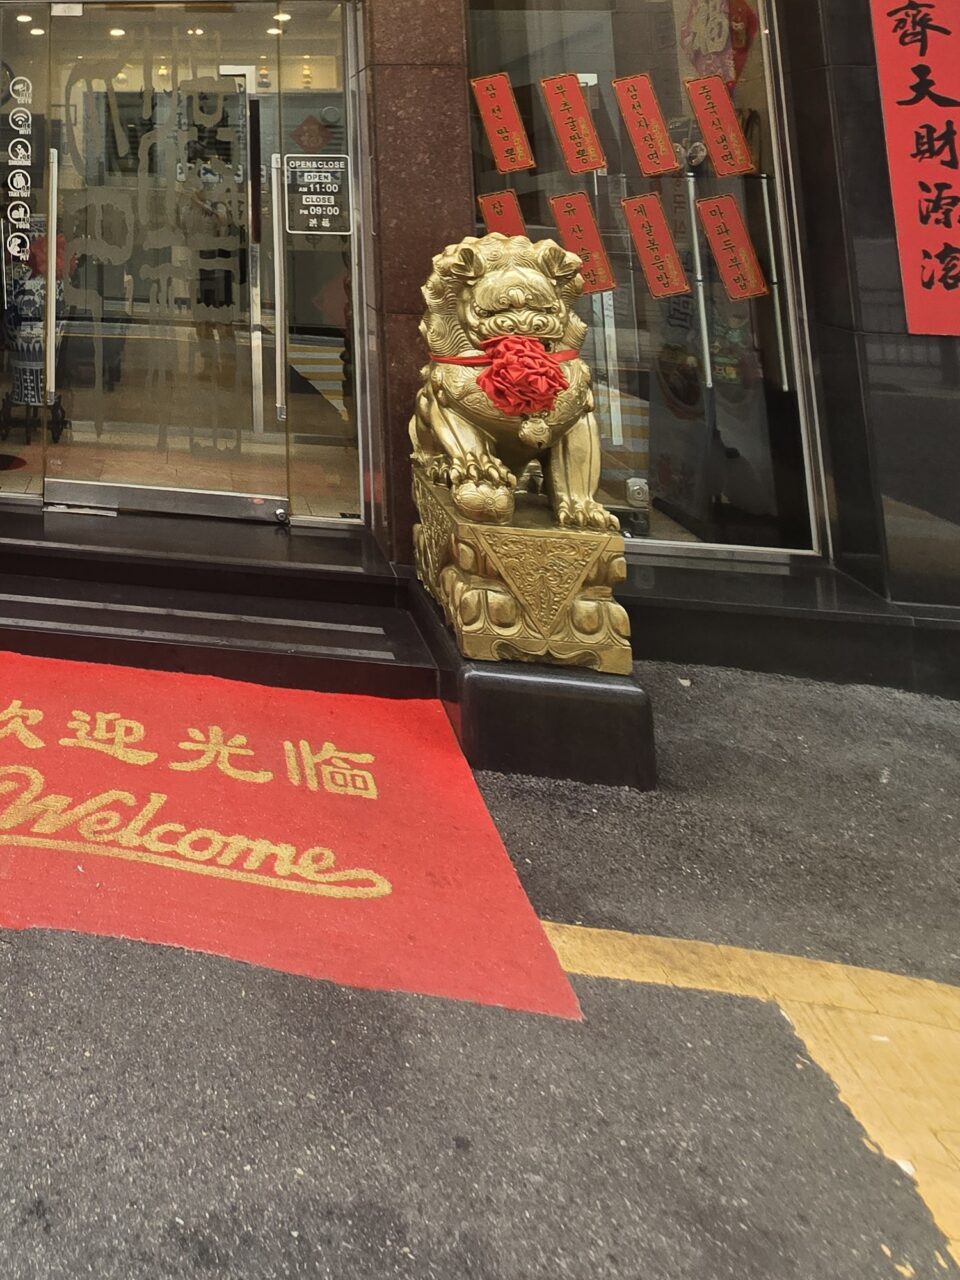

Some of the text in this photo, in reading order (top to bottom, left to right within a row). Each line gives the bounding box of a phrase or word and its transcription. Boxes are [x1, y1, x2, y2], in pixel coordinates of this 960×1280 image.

[309, 184, 339, 192] 11:00
[304, 196, 333, 204] CLOSE
[309, 206, 340, 215] 09:00
